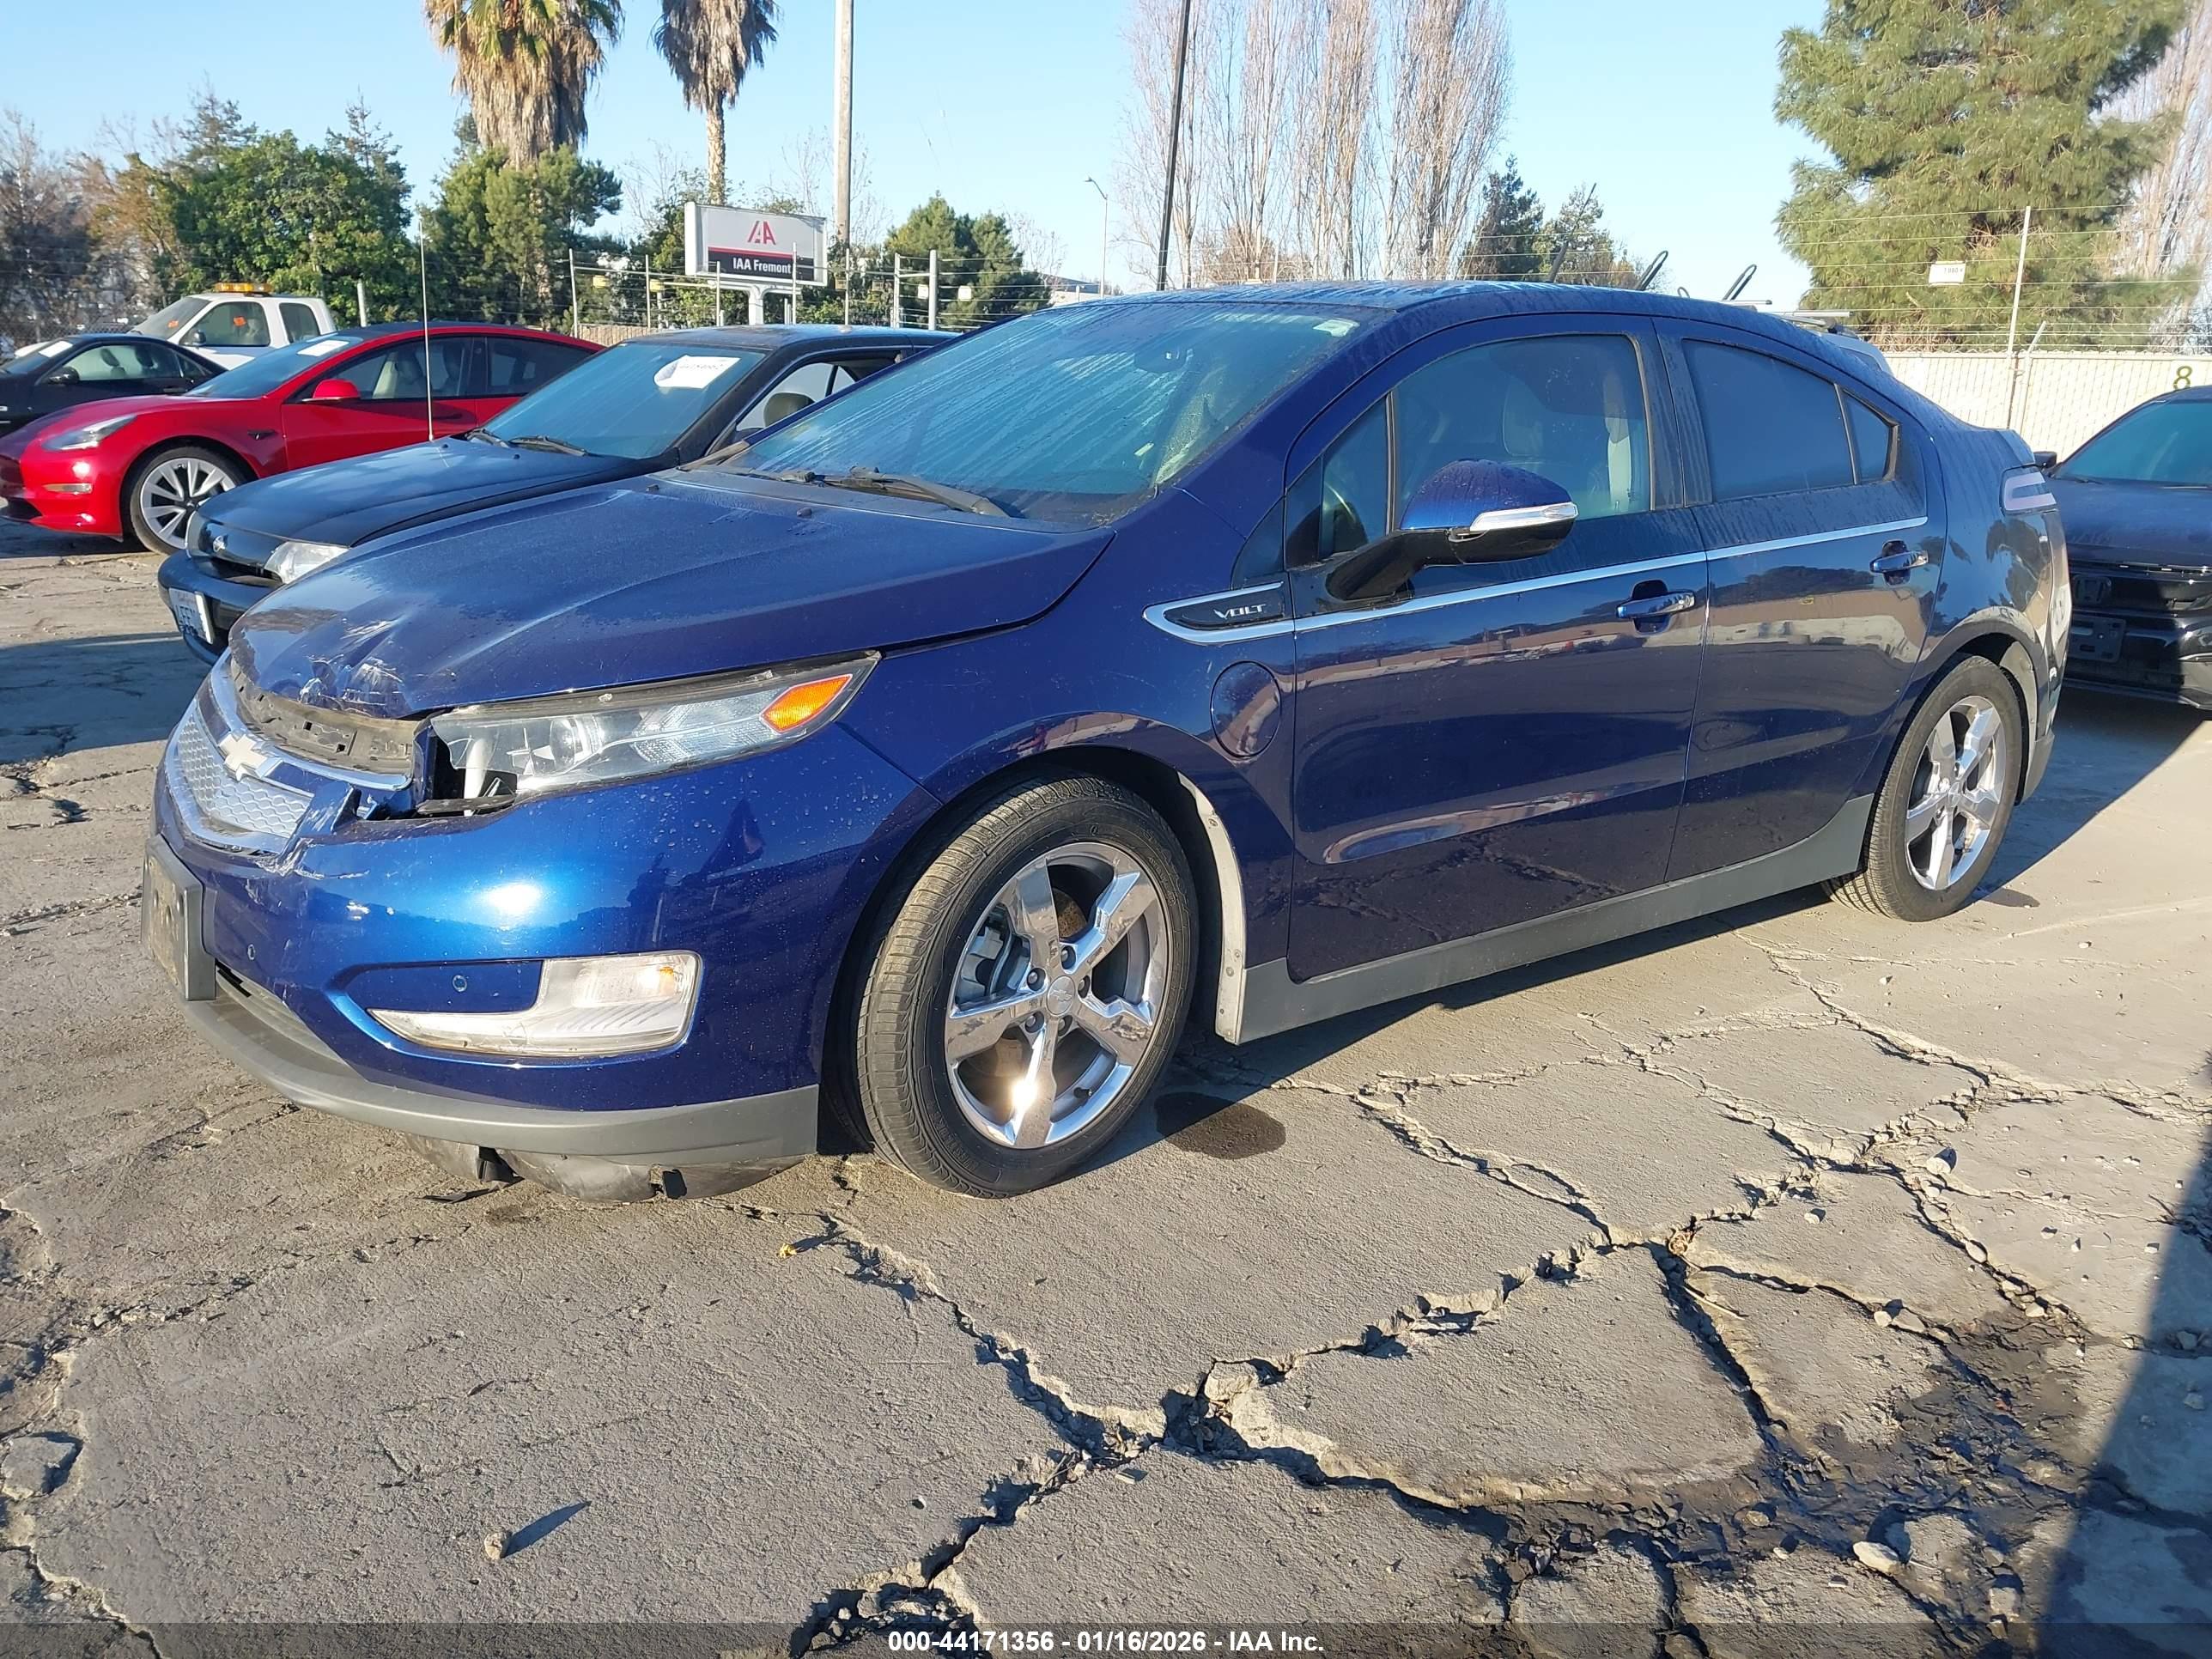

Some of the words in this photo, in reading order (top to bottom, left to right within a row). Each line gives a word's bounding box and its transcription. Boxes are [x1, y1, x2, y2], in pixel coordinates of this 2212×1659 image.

[732, 257, 752, 270] IAA
[753, 258, 792, 274] Fremont
[2172, 365, 2192, 390] 8
[1212, 603, 1267, 620] VOLT
